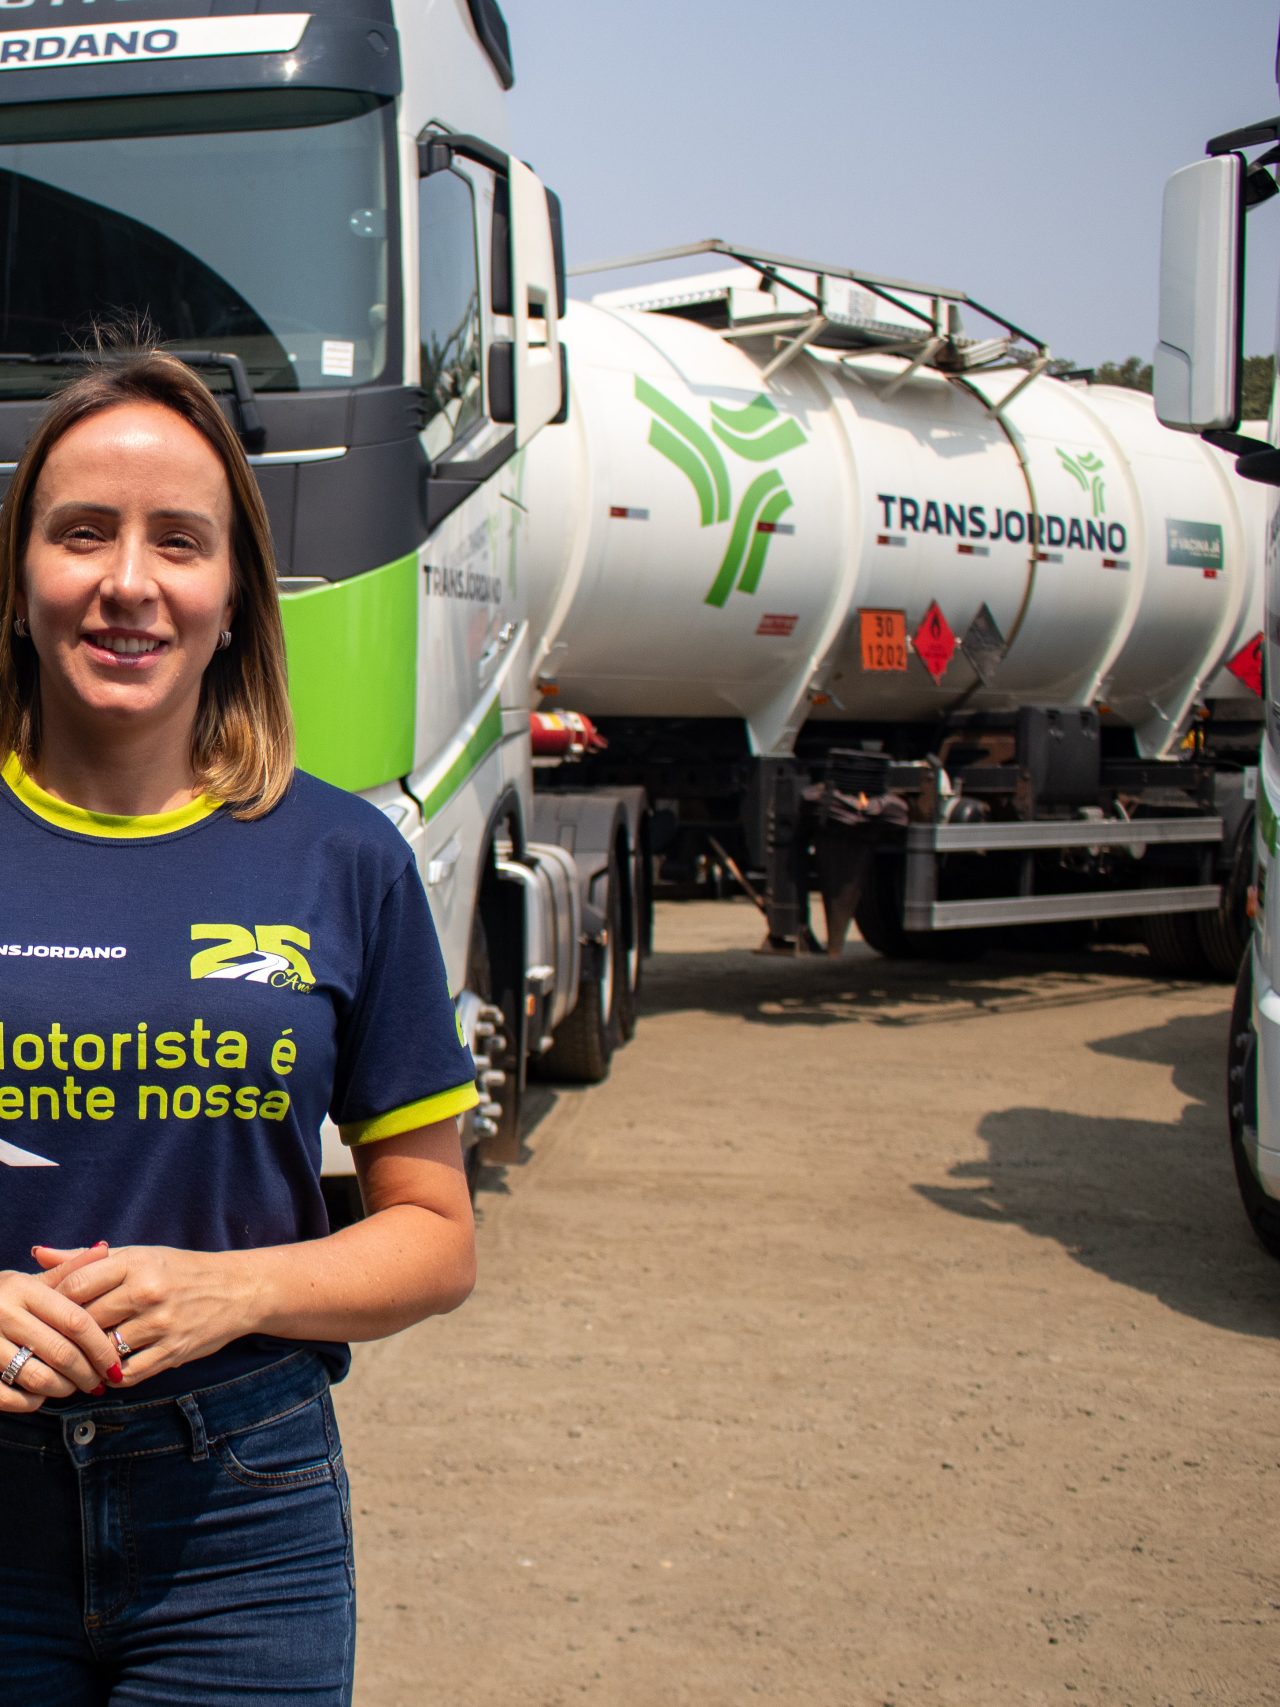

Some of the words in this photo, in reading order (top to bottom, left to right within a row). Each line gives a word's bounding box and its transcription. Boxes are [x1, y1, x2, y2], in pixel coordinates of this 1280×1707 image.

[877, 494, 1127, 554] TRANSJORDANO
[876, 615, 894, 638] 30
[868, 644, 904, 667] 1202
[190, 923, 316, 985] 25
[271, 1028, 298, 1076] é
[138, 1084, 290, 1121] nossa
